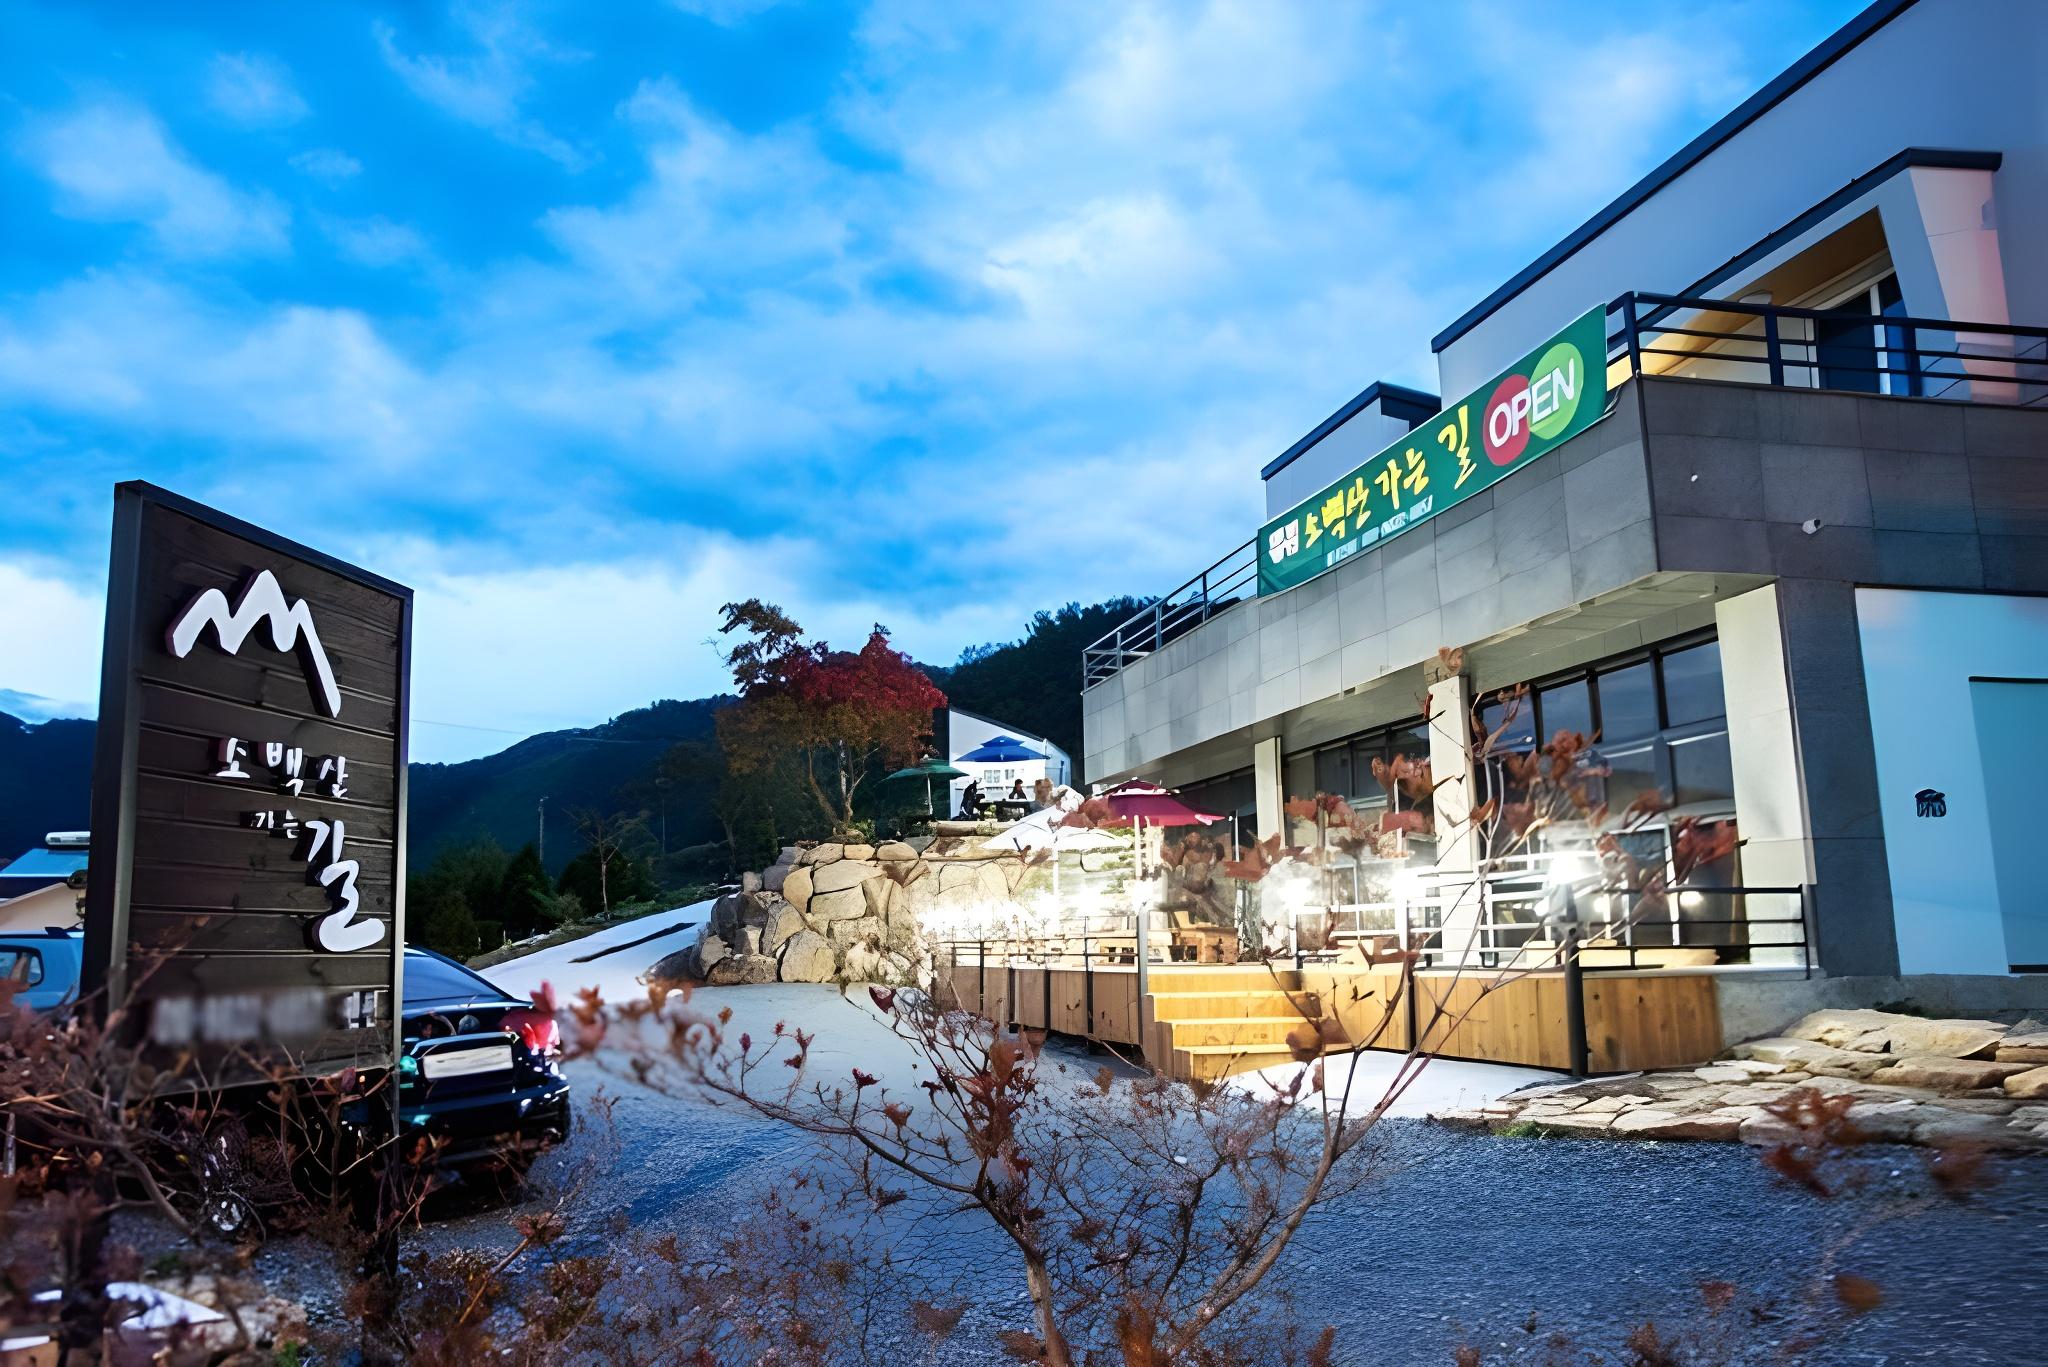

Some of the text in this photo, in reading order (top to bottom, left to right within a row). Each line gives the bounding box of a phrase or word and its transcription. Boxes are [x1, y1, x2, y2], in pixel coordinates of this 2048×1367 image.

[1488, 358, 1575, 448] OPEN
[1304, 477, 1371, 549] 소백산
[1375, 447, 1430, 510] 가는
[1437, 404, 1477, 490] 길
[216, 737, 349, 798] 소백산
[251, 809, 386, 953] 가는 길
